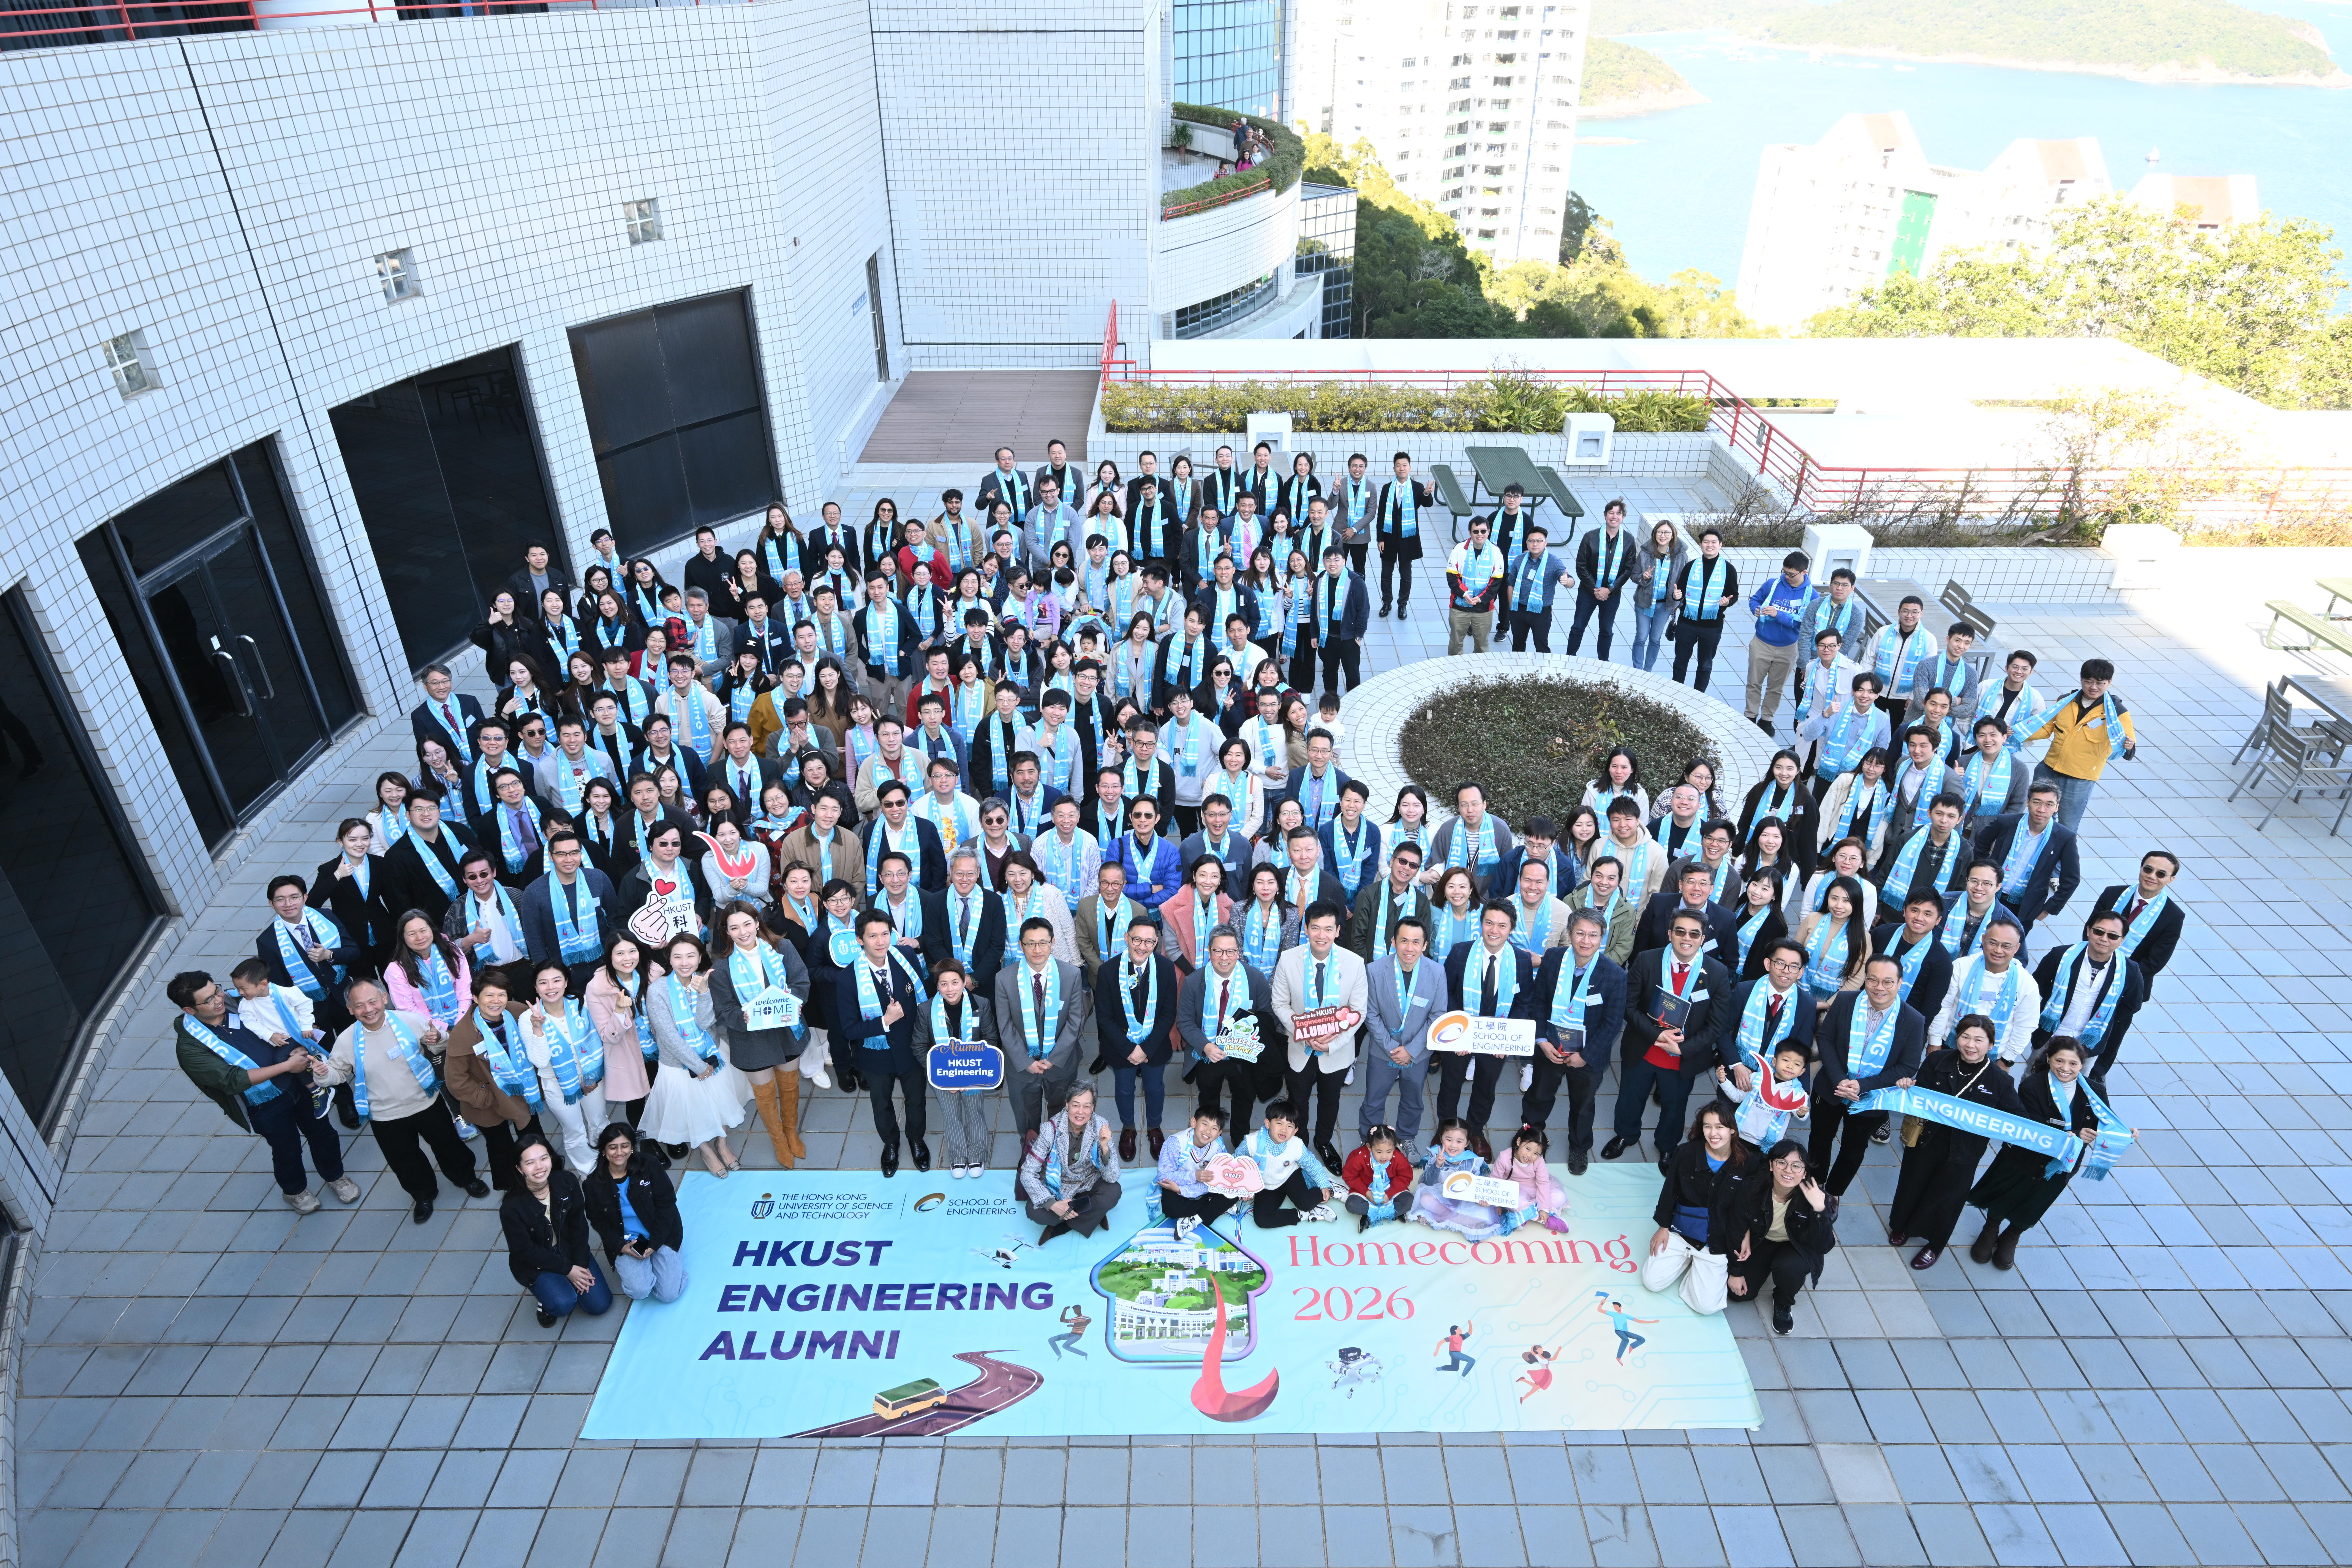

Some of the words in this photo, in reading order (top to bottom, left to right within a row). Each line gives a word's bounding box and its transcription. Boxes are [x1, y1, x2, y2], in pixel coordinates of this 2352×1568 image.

[663, 903, 691, 915] HKUST
[1316, 1008, 1335, 1016] HKUST
[1296, 1016, 1335, 1027] Engineering
[1474, 1021, 1507, 1031] 工學院
[1296, 1022, 1339, 1040] ALUMNI
[1473, 1032, 1508, 1040] SCHOOL
[940, 1040, 986, 1056] Alumni
[1217, 1037, 1263, 1051] ENGINEERING
[1225, 1044, 1253, 1054] ALUMNI
[1473, 1042, 1530, 1052] ENGINEERING
[937, 1068, 994, 1078] Engineering
[1912, 1095, 2053, 1148] ENGINEERING
[1476, 1179, 1499, 1188] 工學院
[1209, 1185, 1253, 1197] ENGINEERING
[1475, 1187, 1500, 1195] SCHOOL
[1475, 1194, 1516, 1206] ENGINEERING
[732, 1240, 893, 1267] HKUST
[1288, 1230, 1638, 1274] Homecoming
[717, 1282, 1054, 1312] ENGINEERING
[1292, 1285, 1415, 1322] 2026
[698, 1330, 900, 1361] ALUMNI
